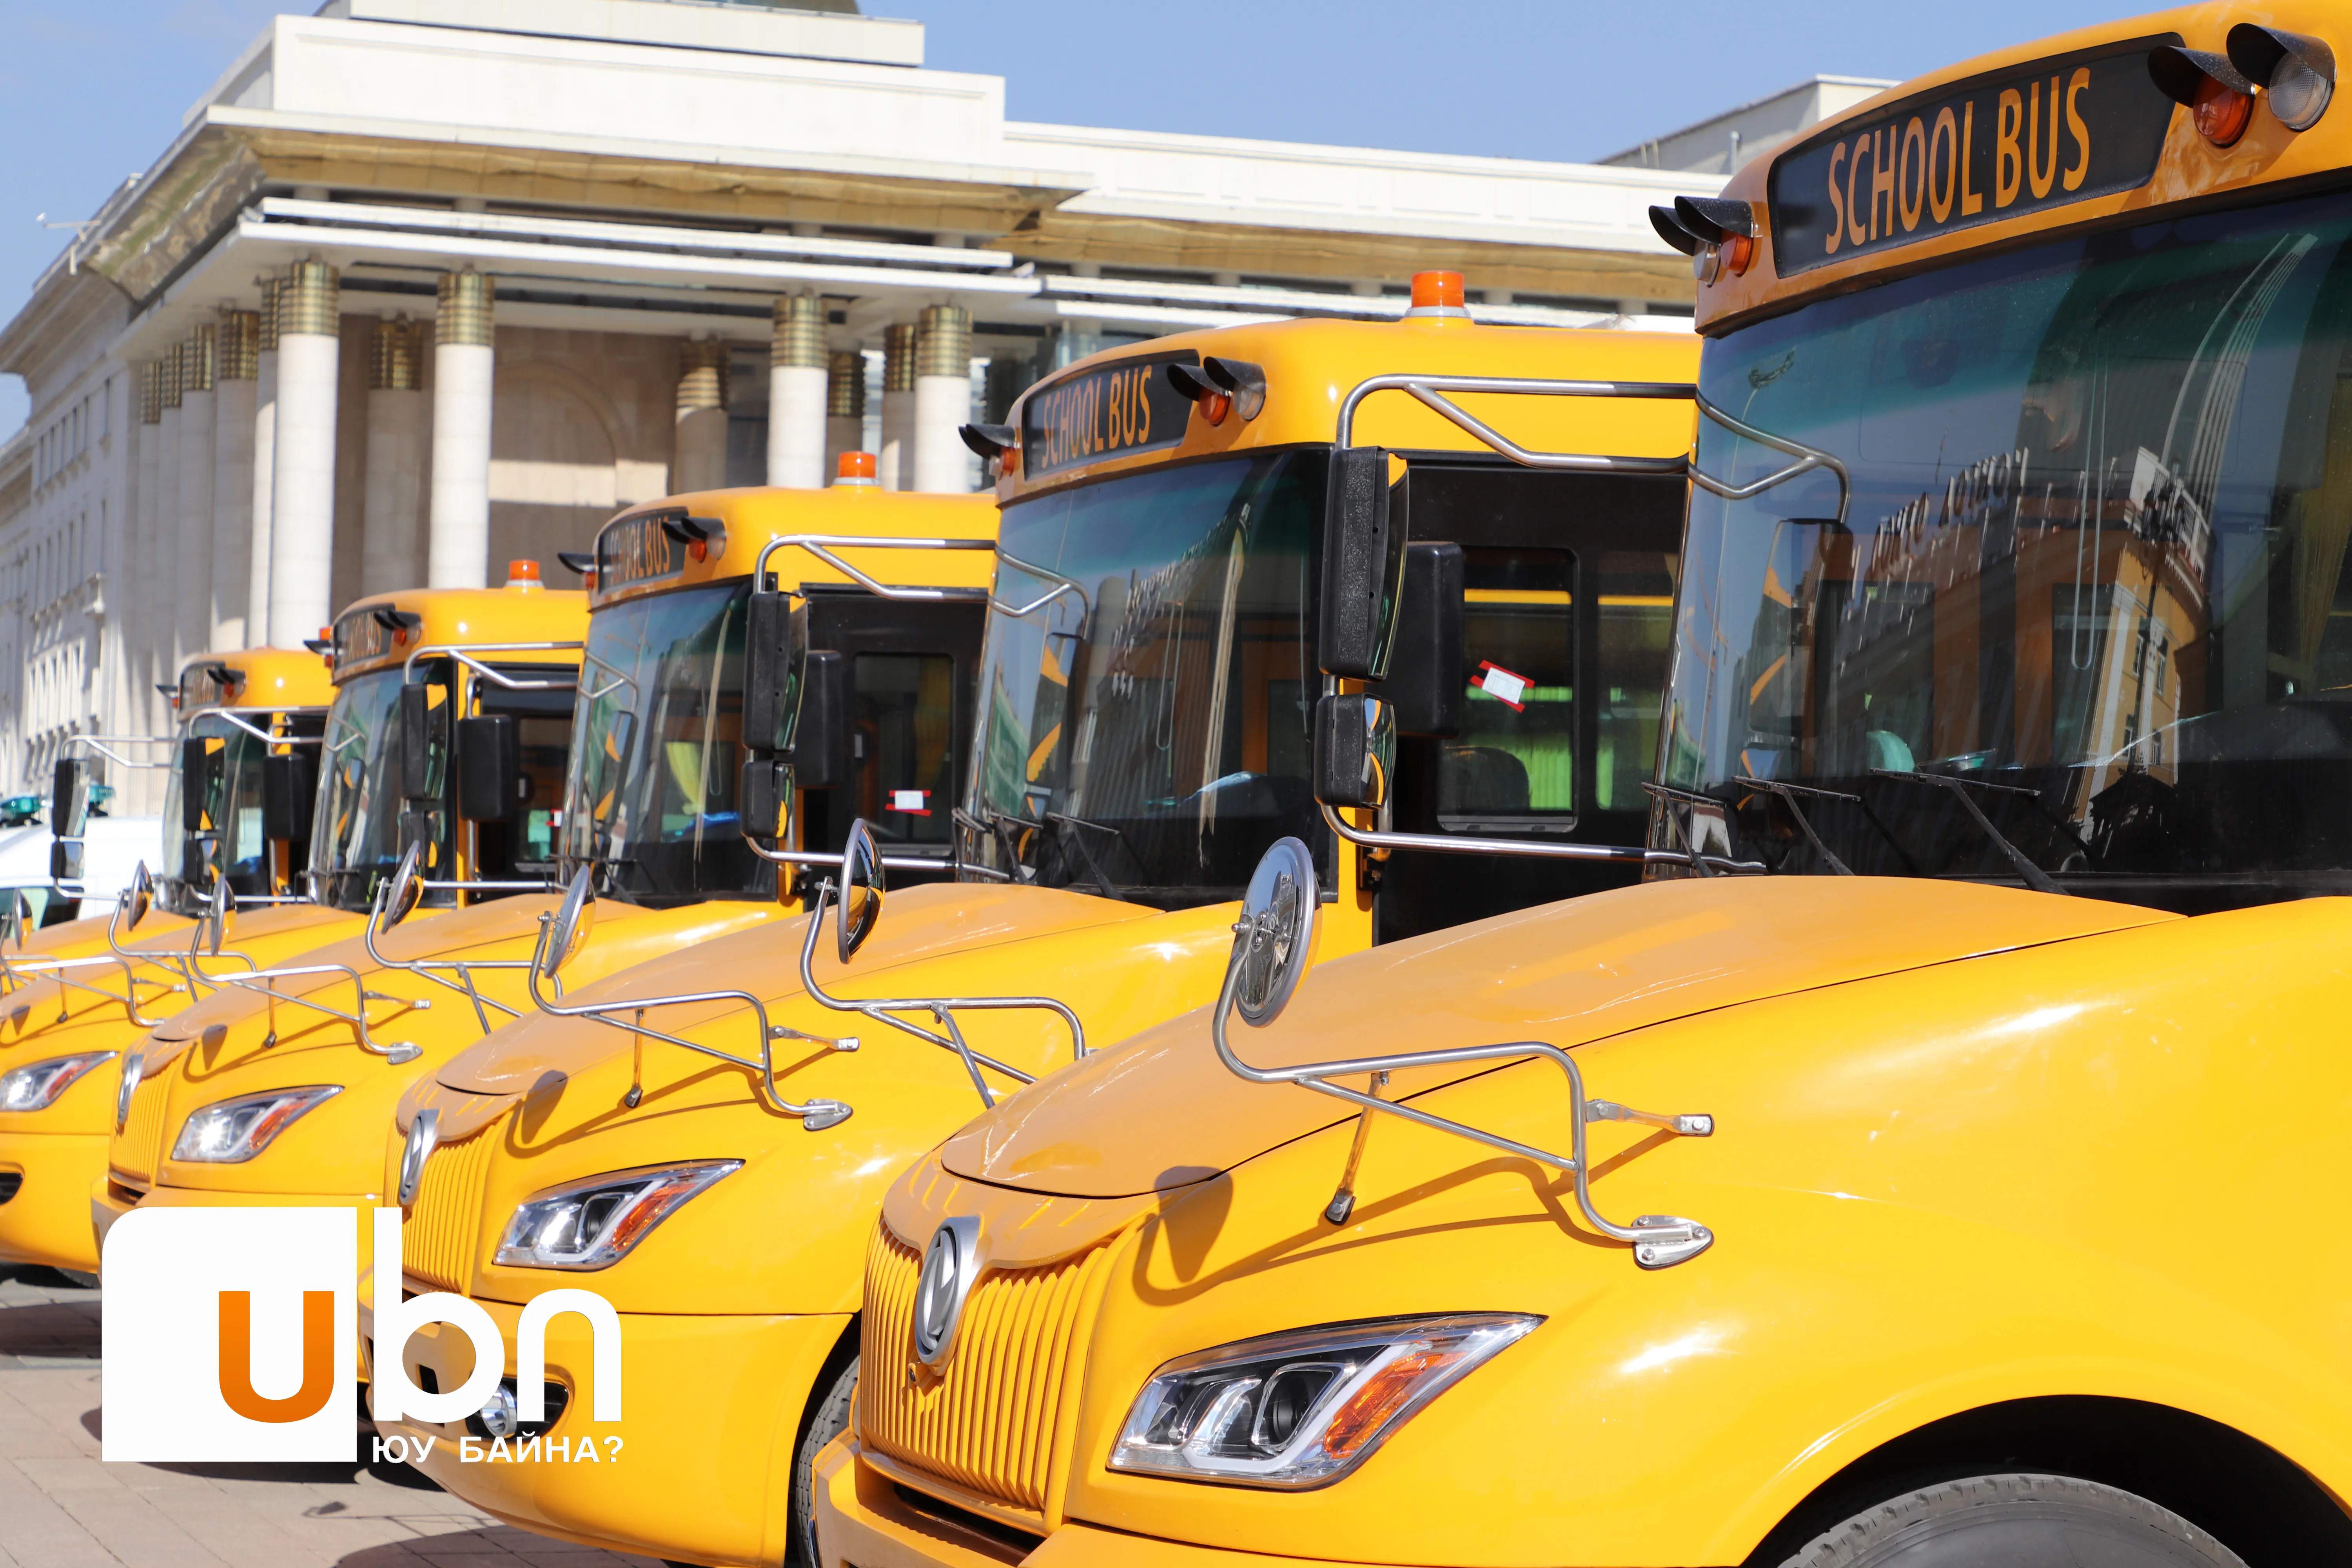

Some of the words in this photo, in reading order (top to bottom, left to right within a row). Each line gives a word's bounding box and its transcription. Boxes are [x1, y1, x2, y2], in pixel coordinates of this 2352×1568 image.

[1825, 101, 1982, 254] SCHOOL
[1996, 67, 2091, 207] BUS
[1042, 377, 1103, 469] SCHOOL
[1109, 364, 1152, 449] BUS
[645, 515, 670, 577] BUS
